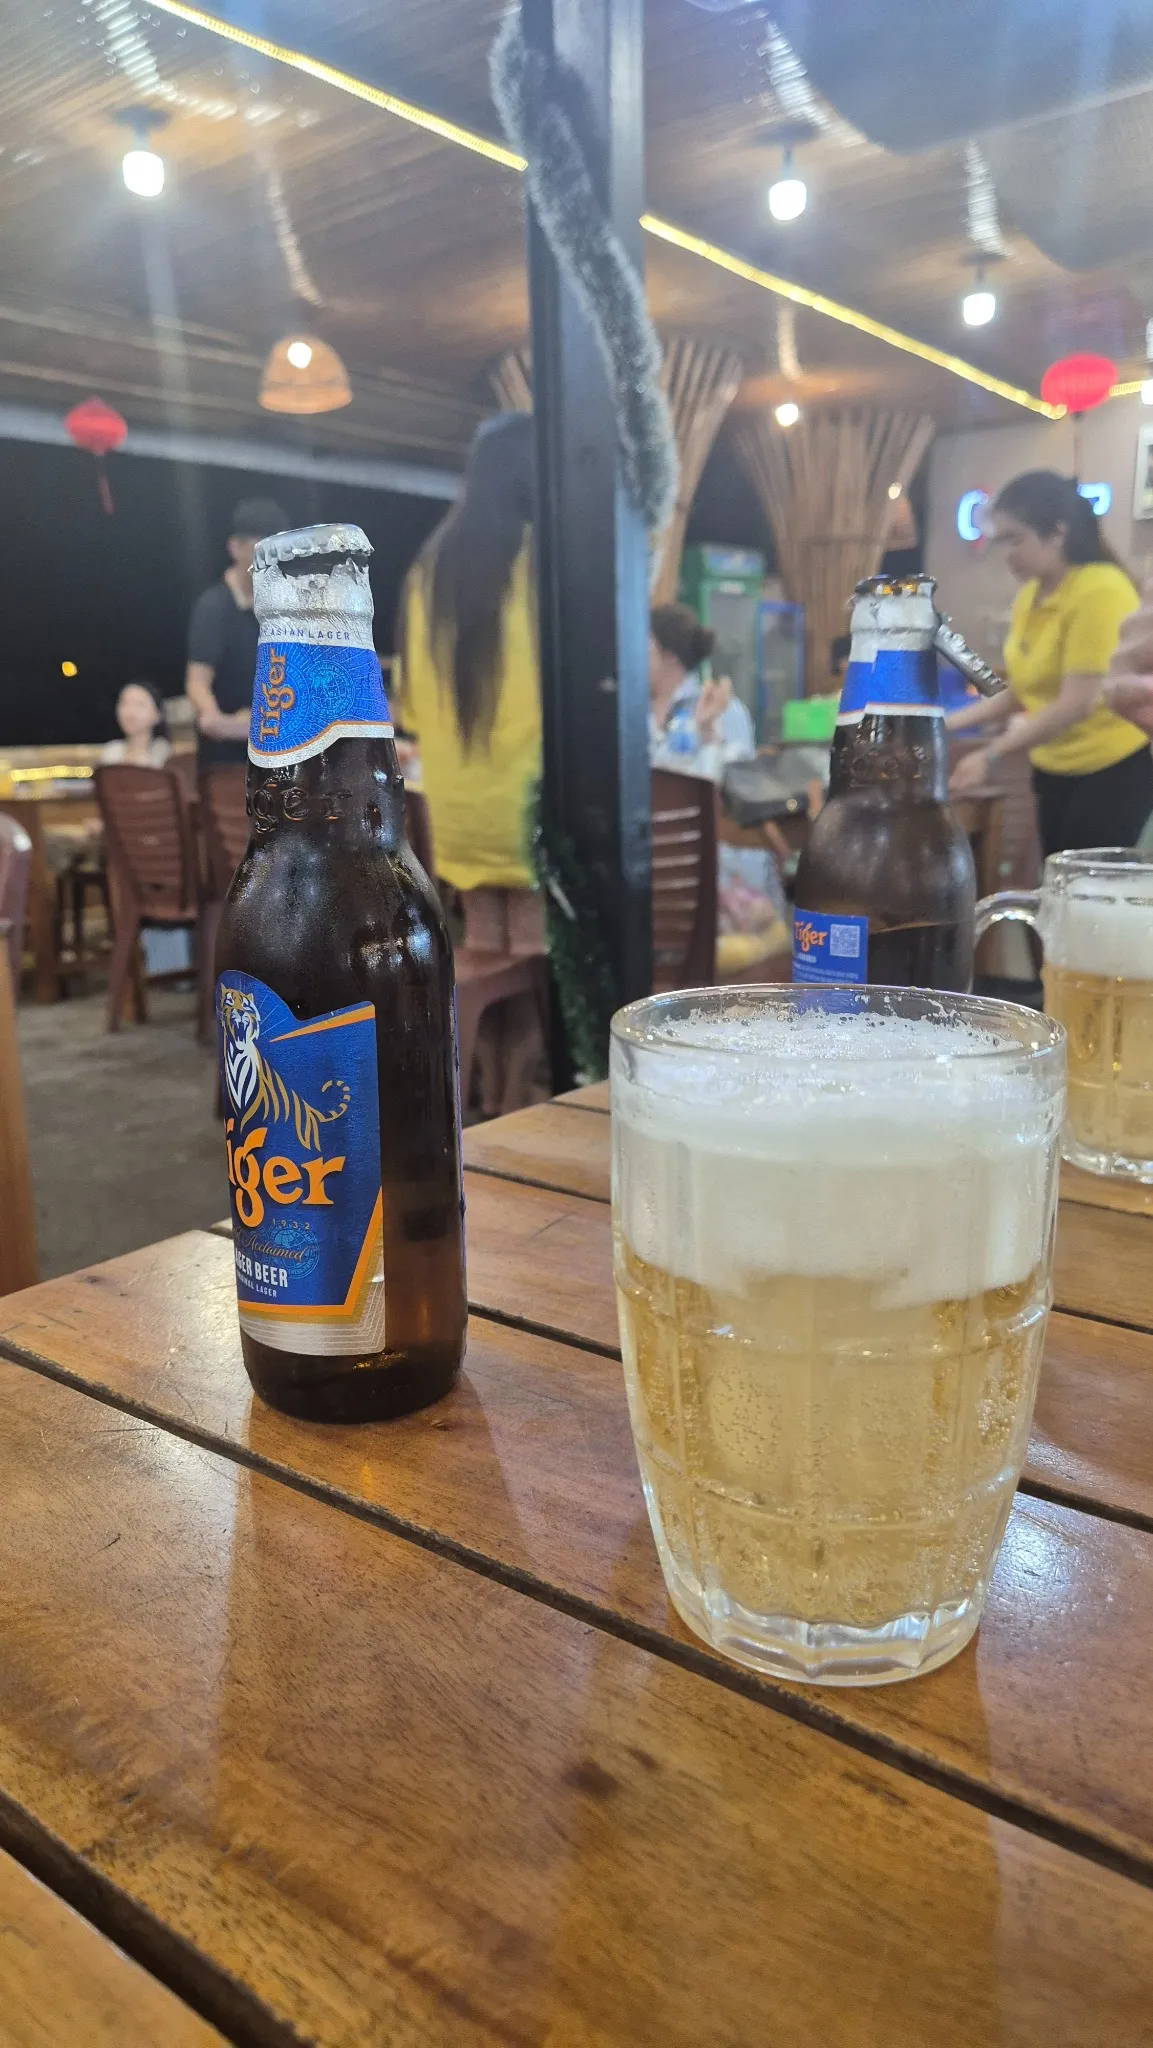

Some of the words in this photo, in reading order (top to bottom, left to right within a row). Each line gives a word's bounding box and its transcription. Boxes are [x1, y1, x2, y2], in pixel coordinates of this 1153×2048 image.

[270, 628, 304, 638] ASIAN
[308, 631, 351, 641] LAGER
[258, 647, 295, 743] Tiger
[223, 1117, 346, 1229] iger
[272, 1218, 310, 1230] 1932
[254, 1261, 289, 1288] BEER
[256, 1284, 278, 1298] LAGER
